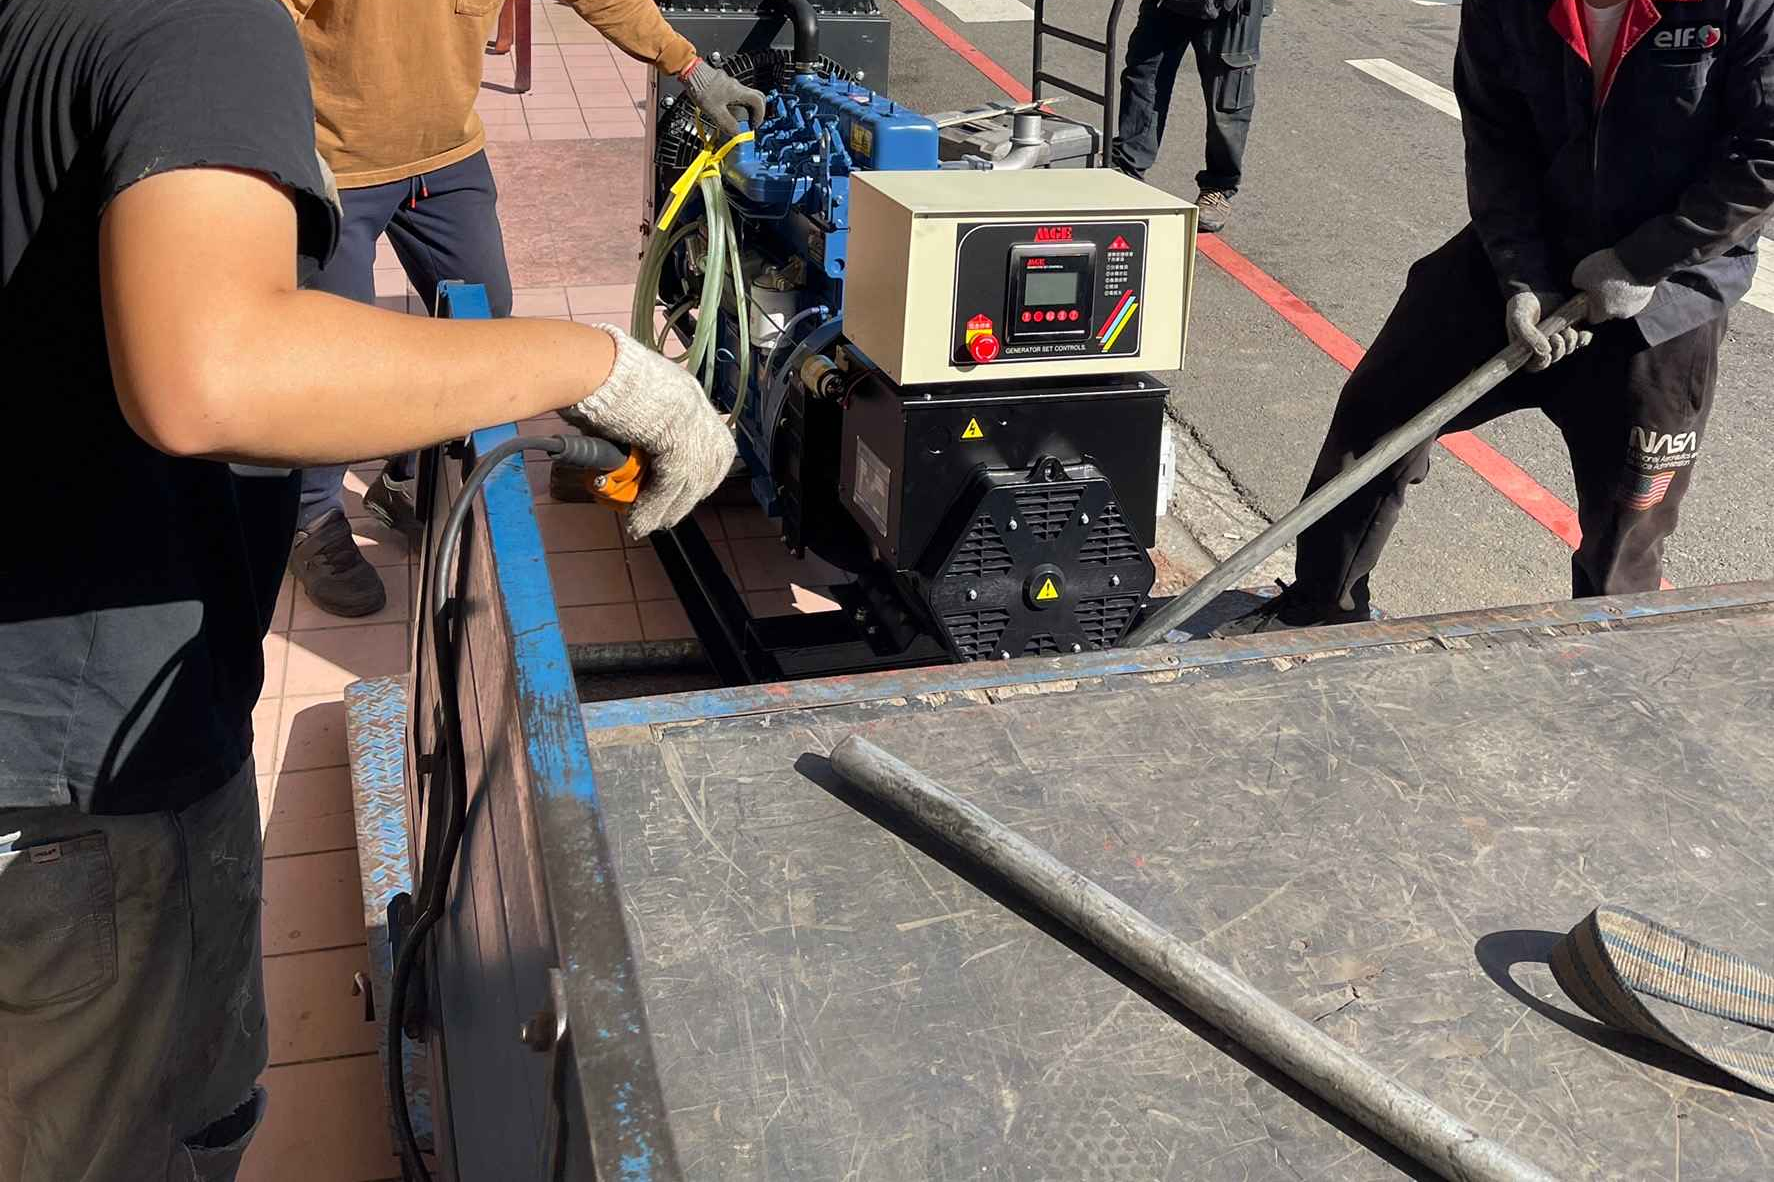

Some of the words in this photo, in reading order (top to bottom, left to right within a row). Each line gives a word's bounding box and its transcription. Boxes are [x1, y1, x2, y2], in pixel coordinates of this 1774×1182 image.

[1654, 28, 1696, 48] elf
[1005, 345, 1041, 355] GENERATOR
[1042, 345, 1054, 353] SET
[1629, 425, 1697, 454] NASA
